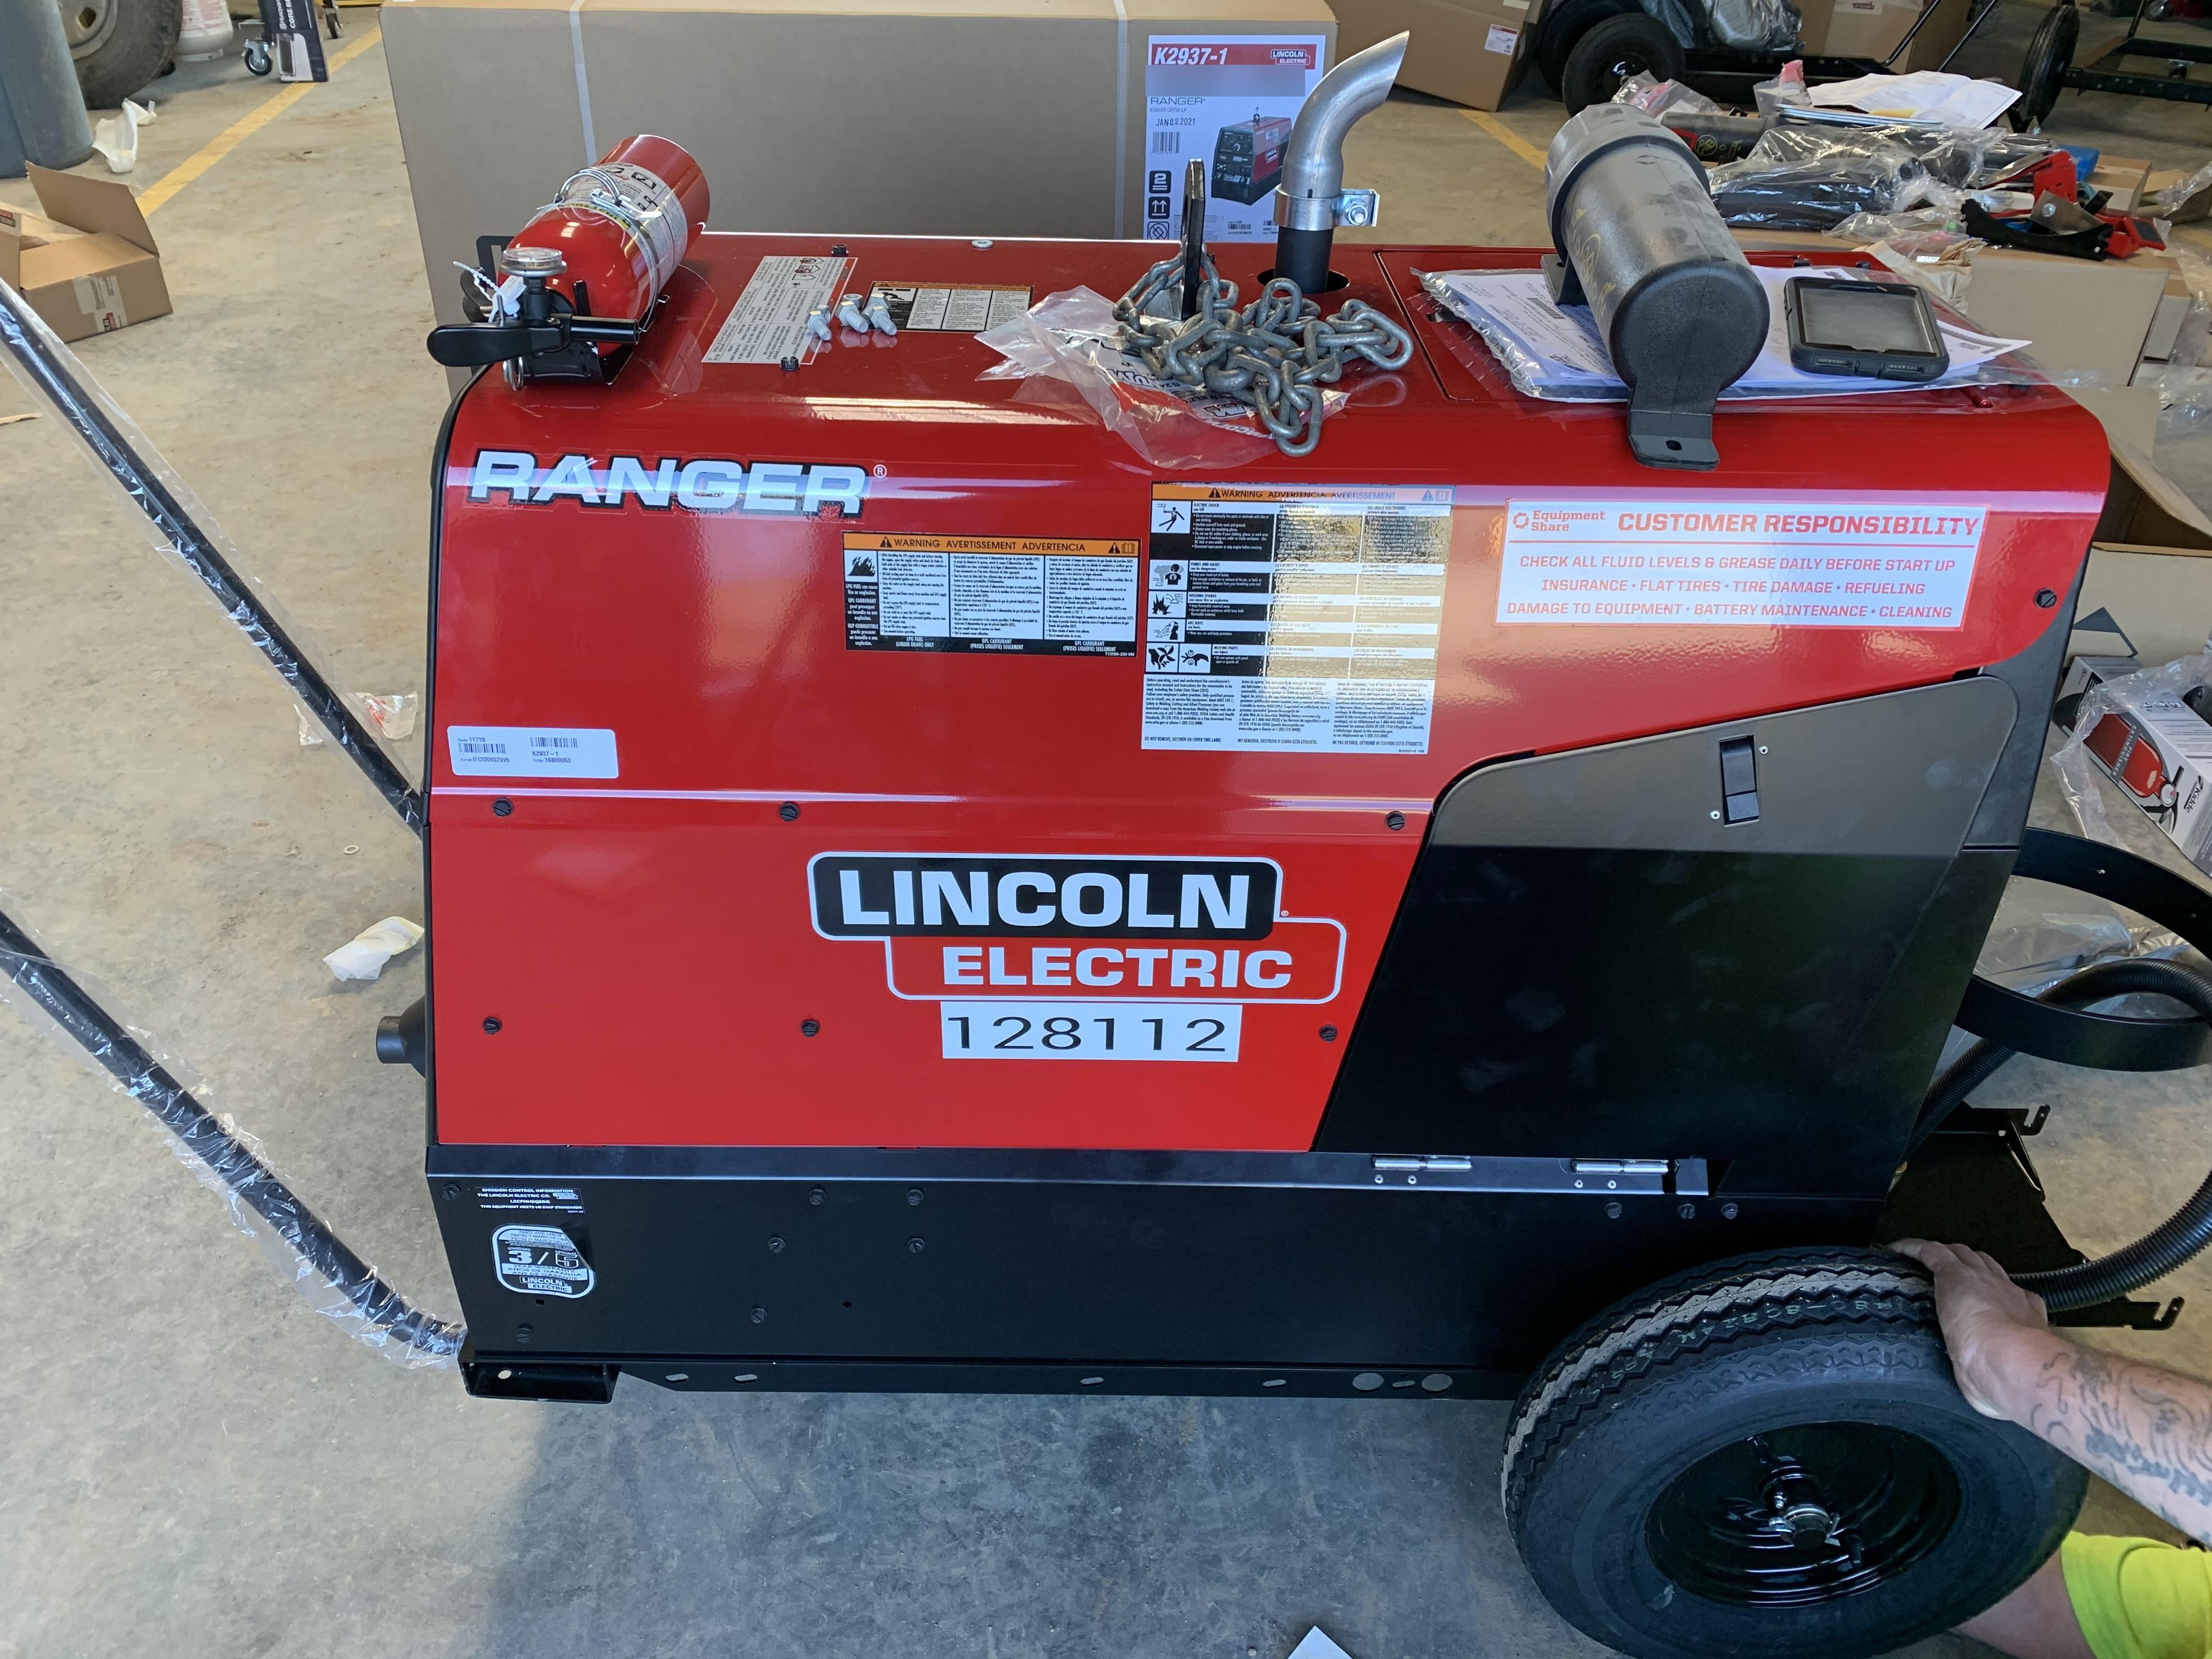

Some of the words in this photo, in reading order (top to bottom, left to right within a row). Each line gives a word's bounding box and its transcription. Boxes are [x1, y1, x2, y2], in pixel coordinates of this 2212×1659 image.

[286, 8, 296, 29] CORE
[1154, 47, 1228, 65] K2937-1
[1221, 490, 1262, 498] WARNING
[1531, 522, 1569, 531] Share
[1532, 511, 1605, 521] Equipment
[1618, 513, 1757, 532] CUSTOMER
[1764, 515, 1979, 535] RESPONSIBILITY
[894, 539, 940, 548] WARNING
[946, 541, 1016, 550] AVERTISSEMENT
[1022, 542, 1085, 551] ADVERTENCIA
[1520, 556, 1568, 567] CHECK
[1572, 556, 1597, 567] ALL
[1601, 556, 1644, 567] FLUID
[1649, 557, 1701, 568] LEVELS
[1705, 557, 1714, 568] &
[1719, 557, 1776, 569] GREASE
[1779, 558, 1822, 569] DAILY
[1826, 558, 1882, 570] BEFORE
[1885, 560, 1932, 571] START
[1935, 560, 1955, 571] UP
[1542, 580, 1628, 591] INSURANCE
[1640, 580, 1673, 591] FLAT
[1678, 581, 1720, 591] TIRES
[1734, 581, 1767, 592] TIRE
[1770, 582, 1833, 593] DAMAGE
[1844, 583, 1925, 594] REFUELING
[1508, 602, 1569, 614] DAMAGE
[1573, 603, 1590, 614] TO
[1595, 603, 1682, 615] EQUIPMENT
[1694, 604, 1758, 616] BATTERY
[1761, 605, 1868, 616] MAINTENANCE
[1880, 606, 1952, 618] CLEANING
[2113, 725, 2137, 776] EXTINGUISHER
[2124, 747, 2132, 761] FIRE
[2186, 788, 2202, 813] Kidde
[840, 870, 1249, 929] LINCOLN
[943, 946, 1291, 989] ELECTRIC
[948, 1015, 1225, 1052] 128112
[509, 1251, 532, 1263] 3
[555, 1253, 579, 1268] 5
[522, 1278, 562, 1286] LINCOLN
[533, 1284, 567, 1292] ELECTRIC
